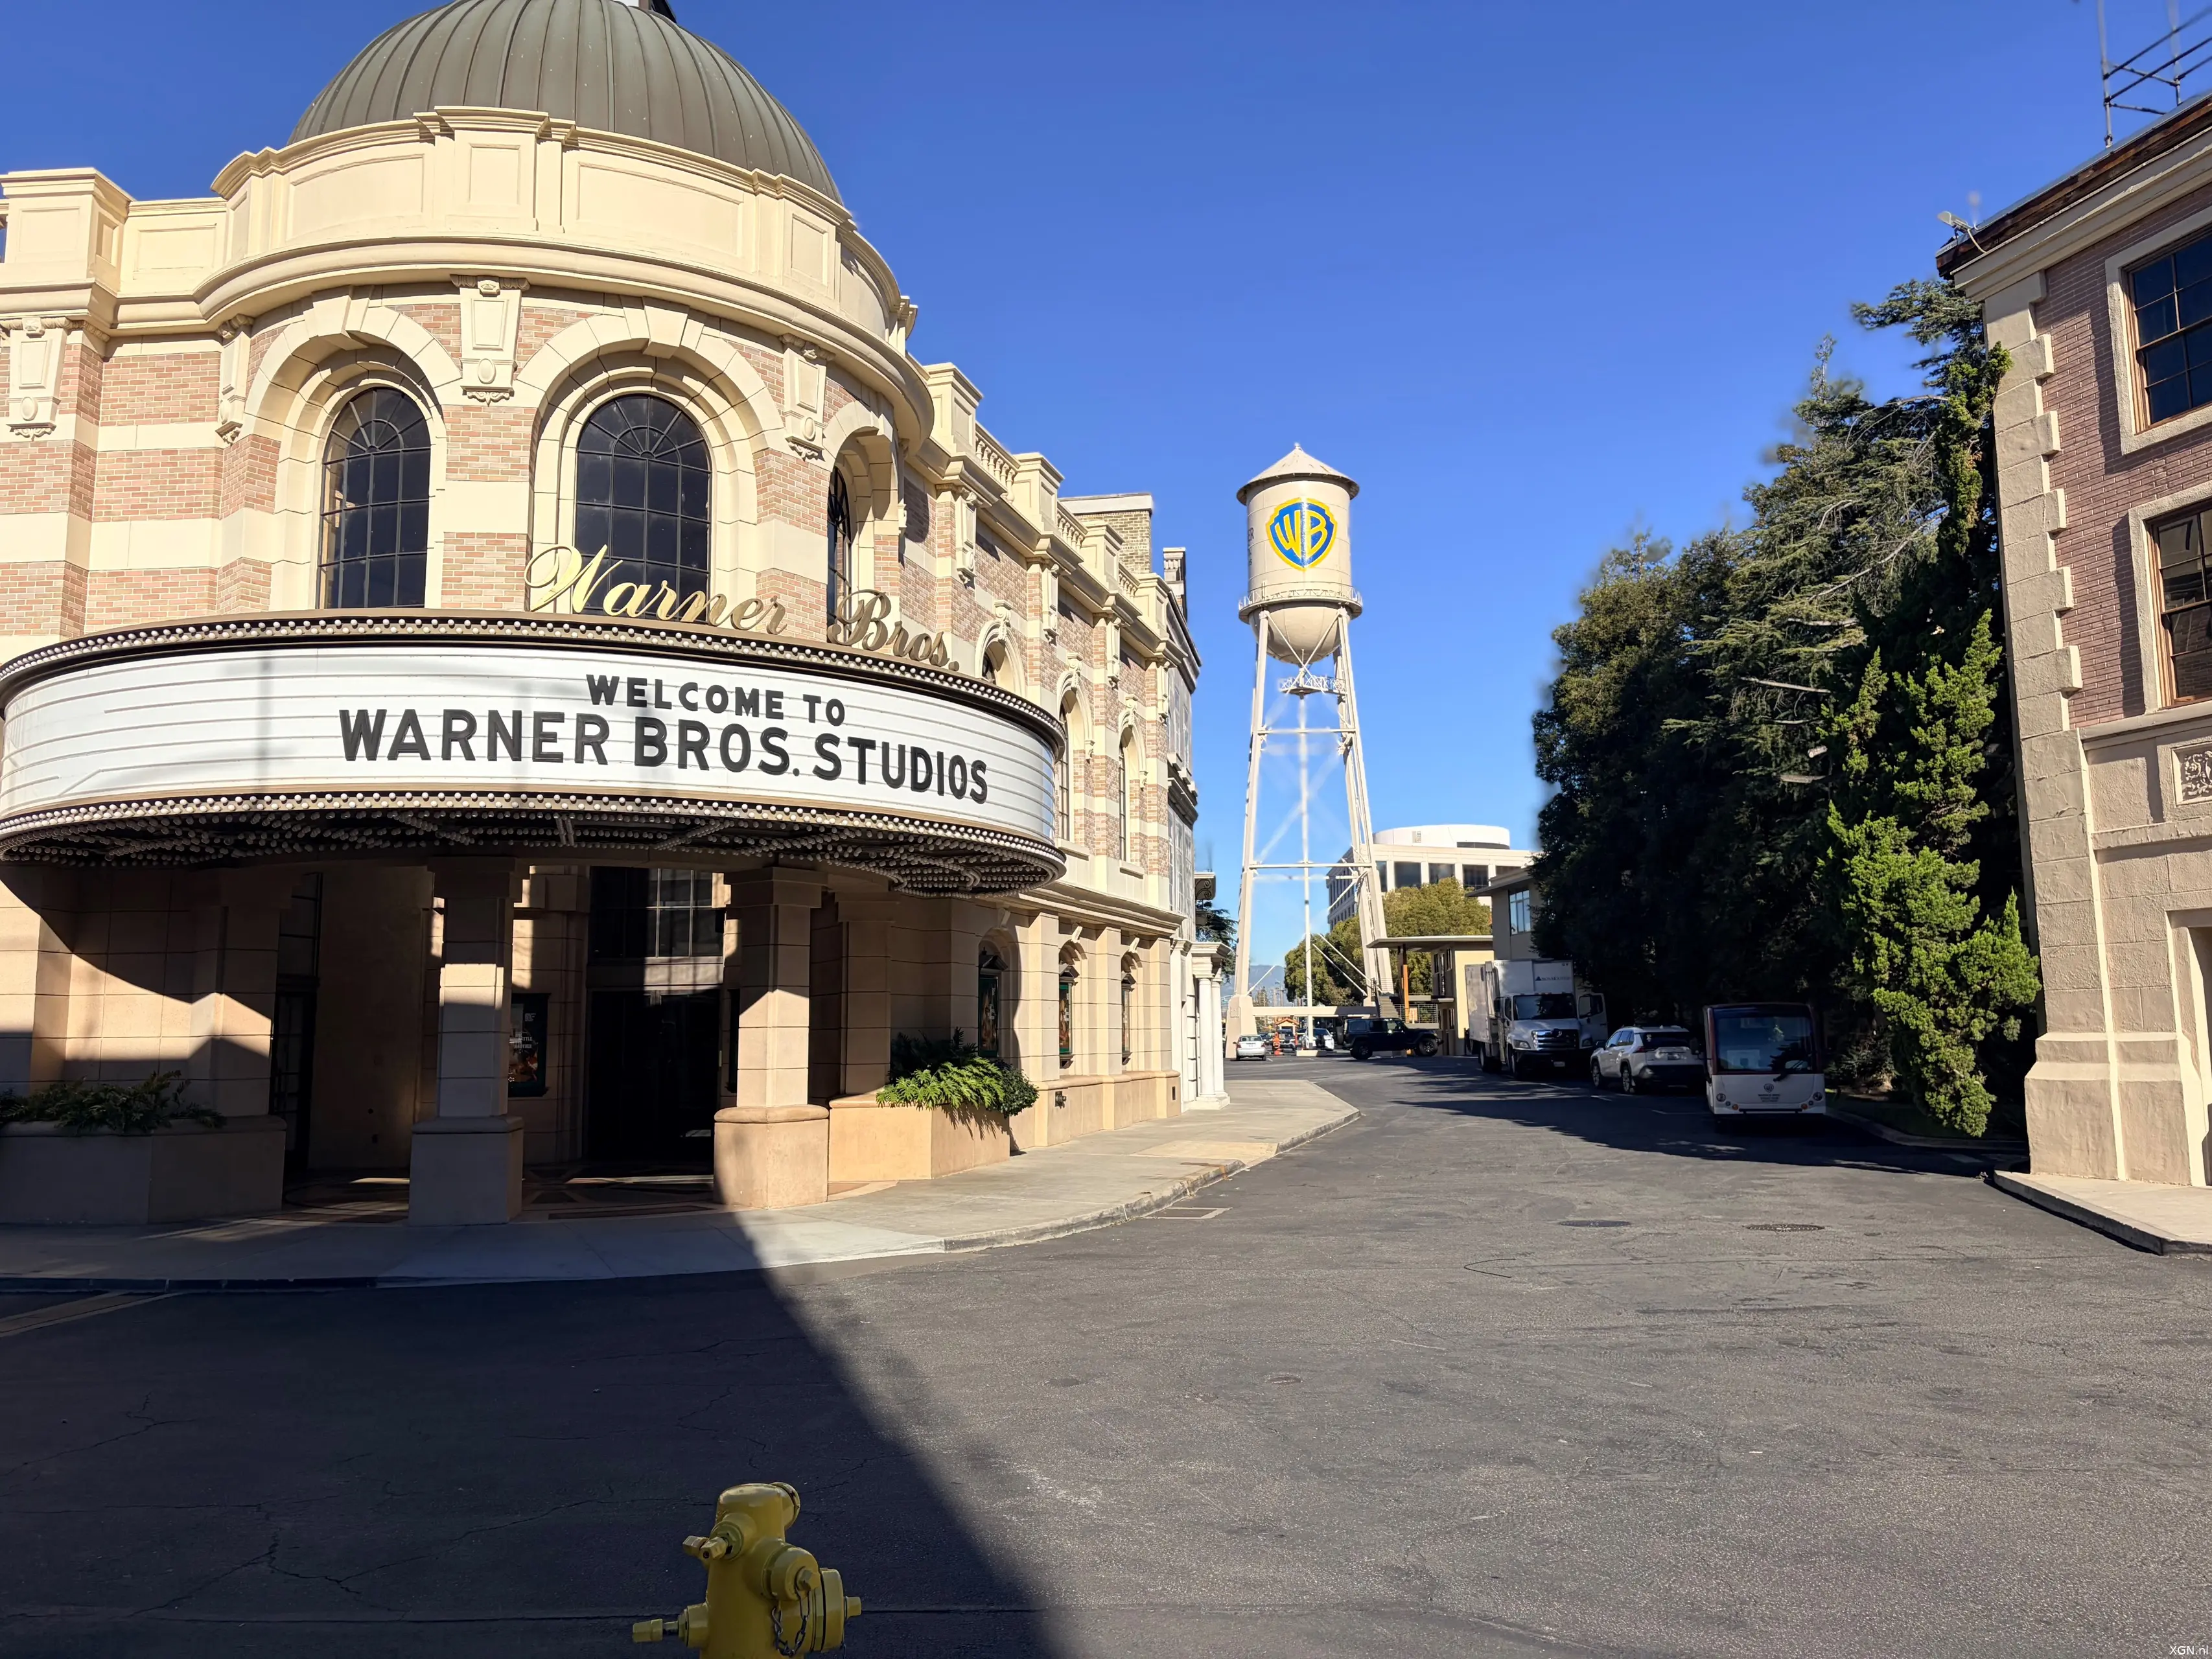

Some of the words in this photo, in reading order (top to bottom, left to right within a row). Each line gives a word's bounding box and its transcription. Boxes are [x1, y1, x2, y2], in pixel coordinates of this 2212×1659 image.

[1274, 509, 1328, 561] WB
[524, 544, 787, 634] Warner
[827, 589, 959, 671] Bros.
[587, 675, 784, 720] WELCOME
[802, 695, 845, 726] TO
[339, 709, 610, 765] WARNER
[634, 716, 800, 776] BROS.
[812, 733, 988, 804] STUDIOS
